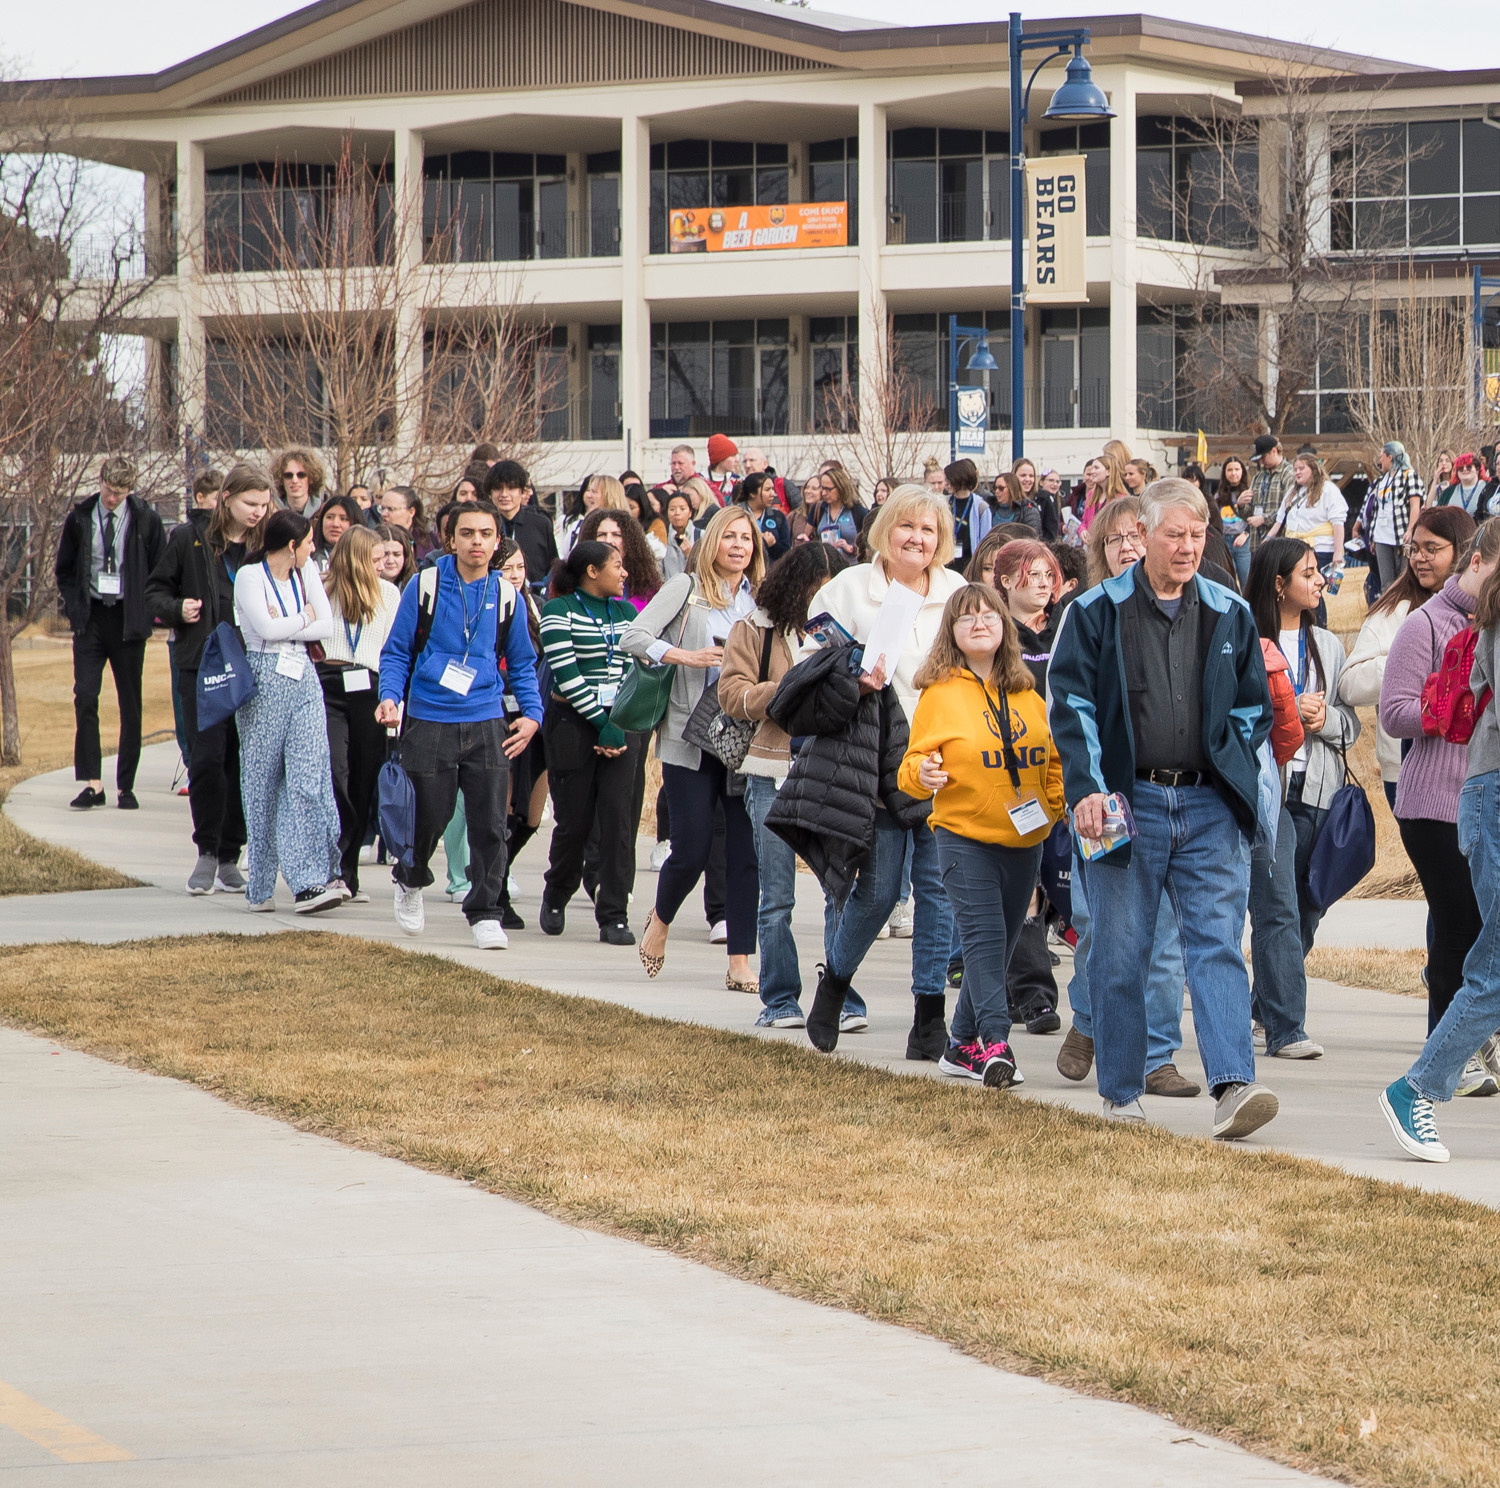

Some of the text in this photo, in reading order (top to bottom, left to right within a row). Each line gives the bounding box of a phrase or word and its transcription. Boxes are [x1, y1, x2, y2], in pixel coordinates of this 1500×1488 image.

[1057, 174, 1076, 213] GO
[738, 211, 748, 229] A
[821, 206, 845, 215] ENJOY
[722, 225, 798, 249] BEER GARDEN
[1036, 176, 1056, 284] BEARS
[204, 673, 227, 685] UNC
